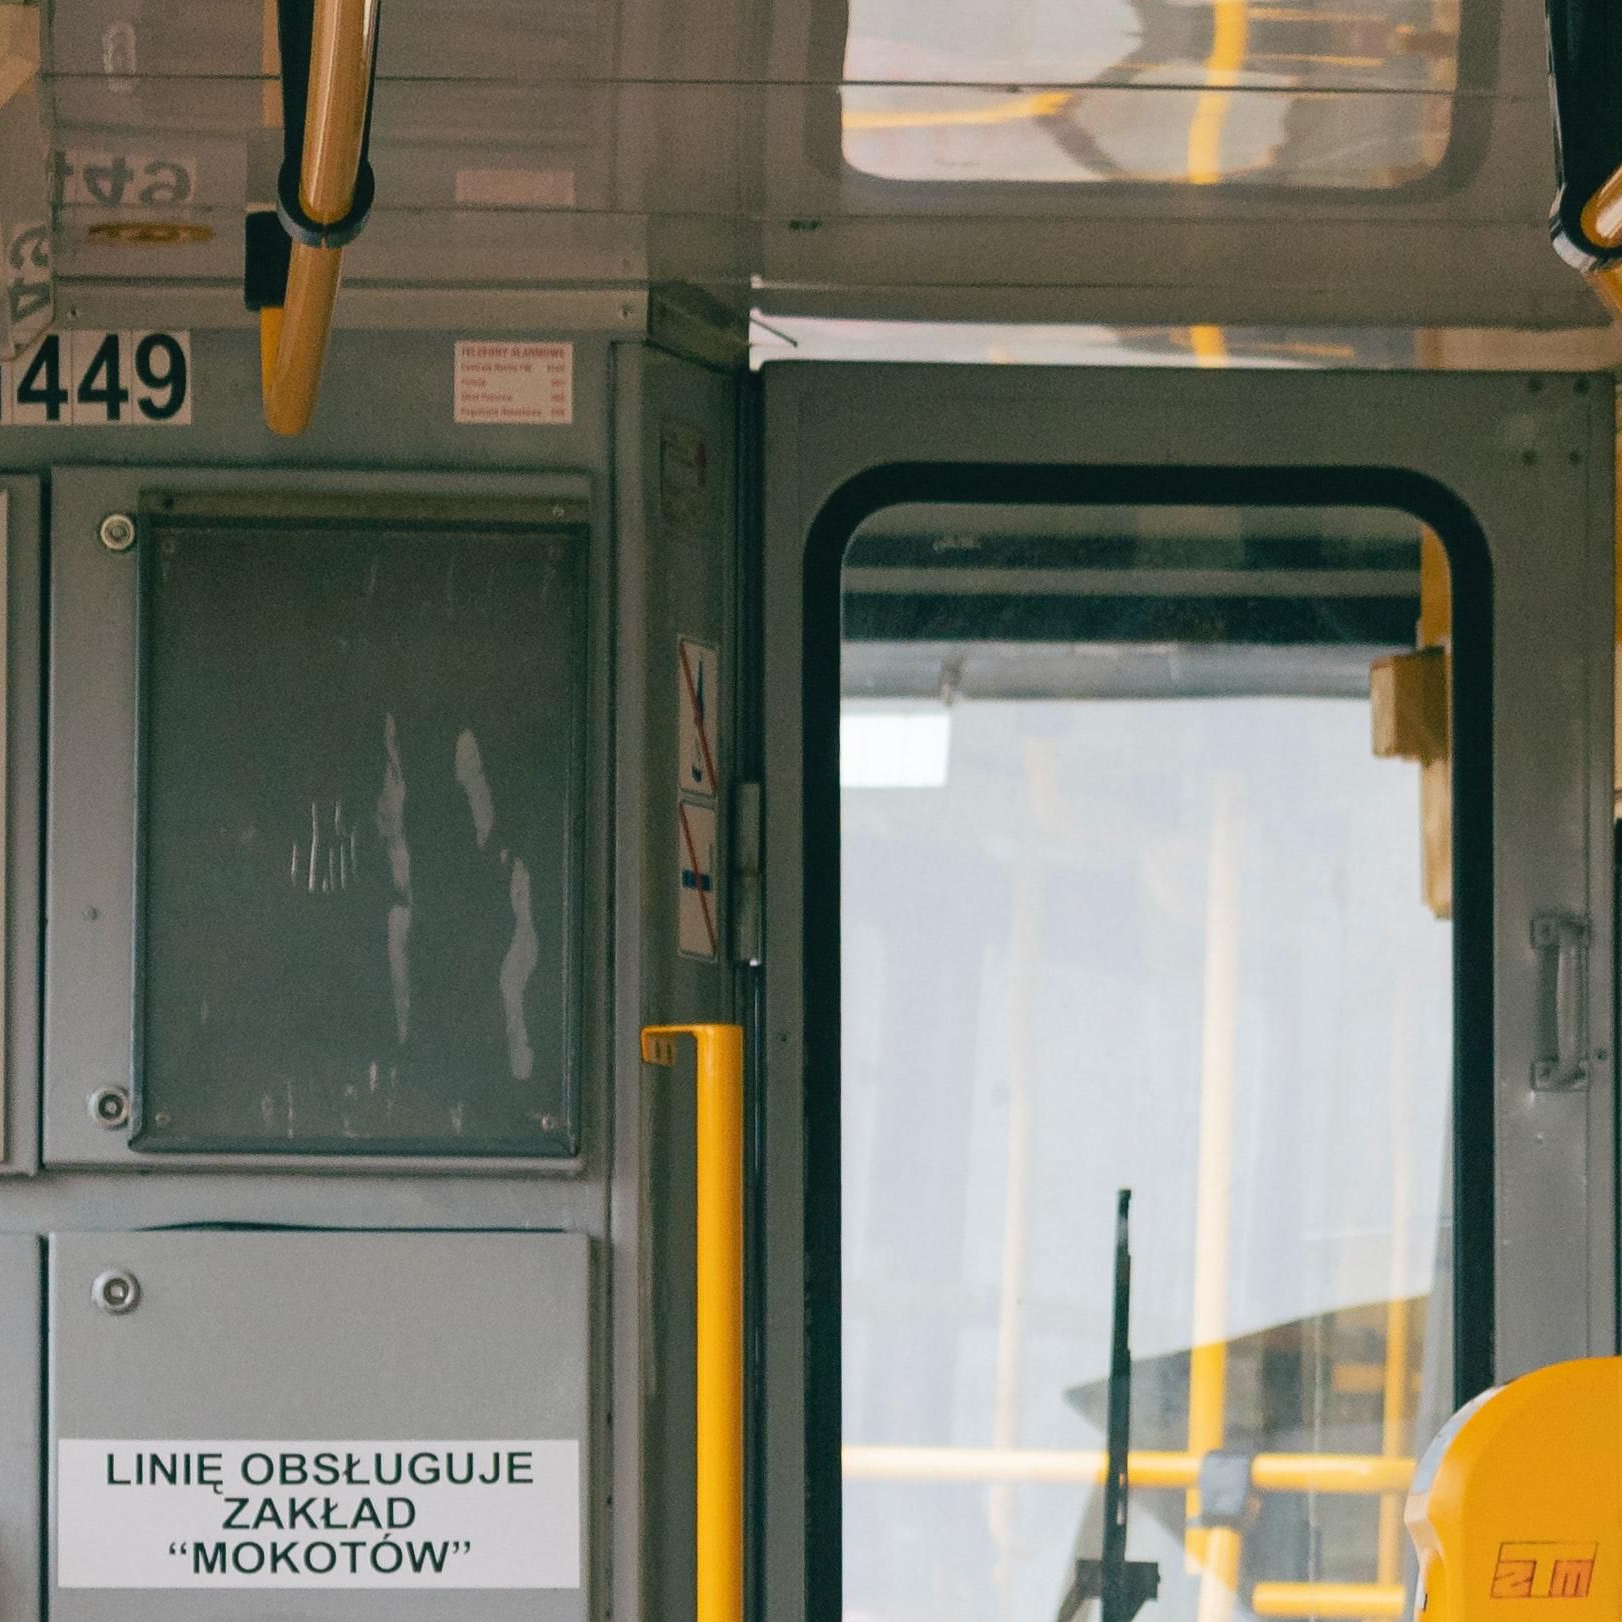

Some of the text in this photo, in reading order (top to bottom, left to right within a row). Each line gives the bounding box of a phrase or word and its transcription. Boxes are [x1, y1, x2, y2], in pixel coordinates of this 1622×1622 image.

[106, 1452, 534, 1495] LINIĘ OBSŁUGUJE
[222, 1497, 417, 1530] ZAKŁAD
